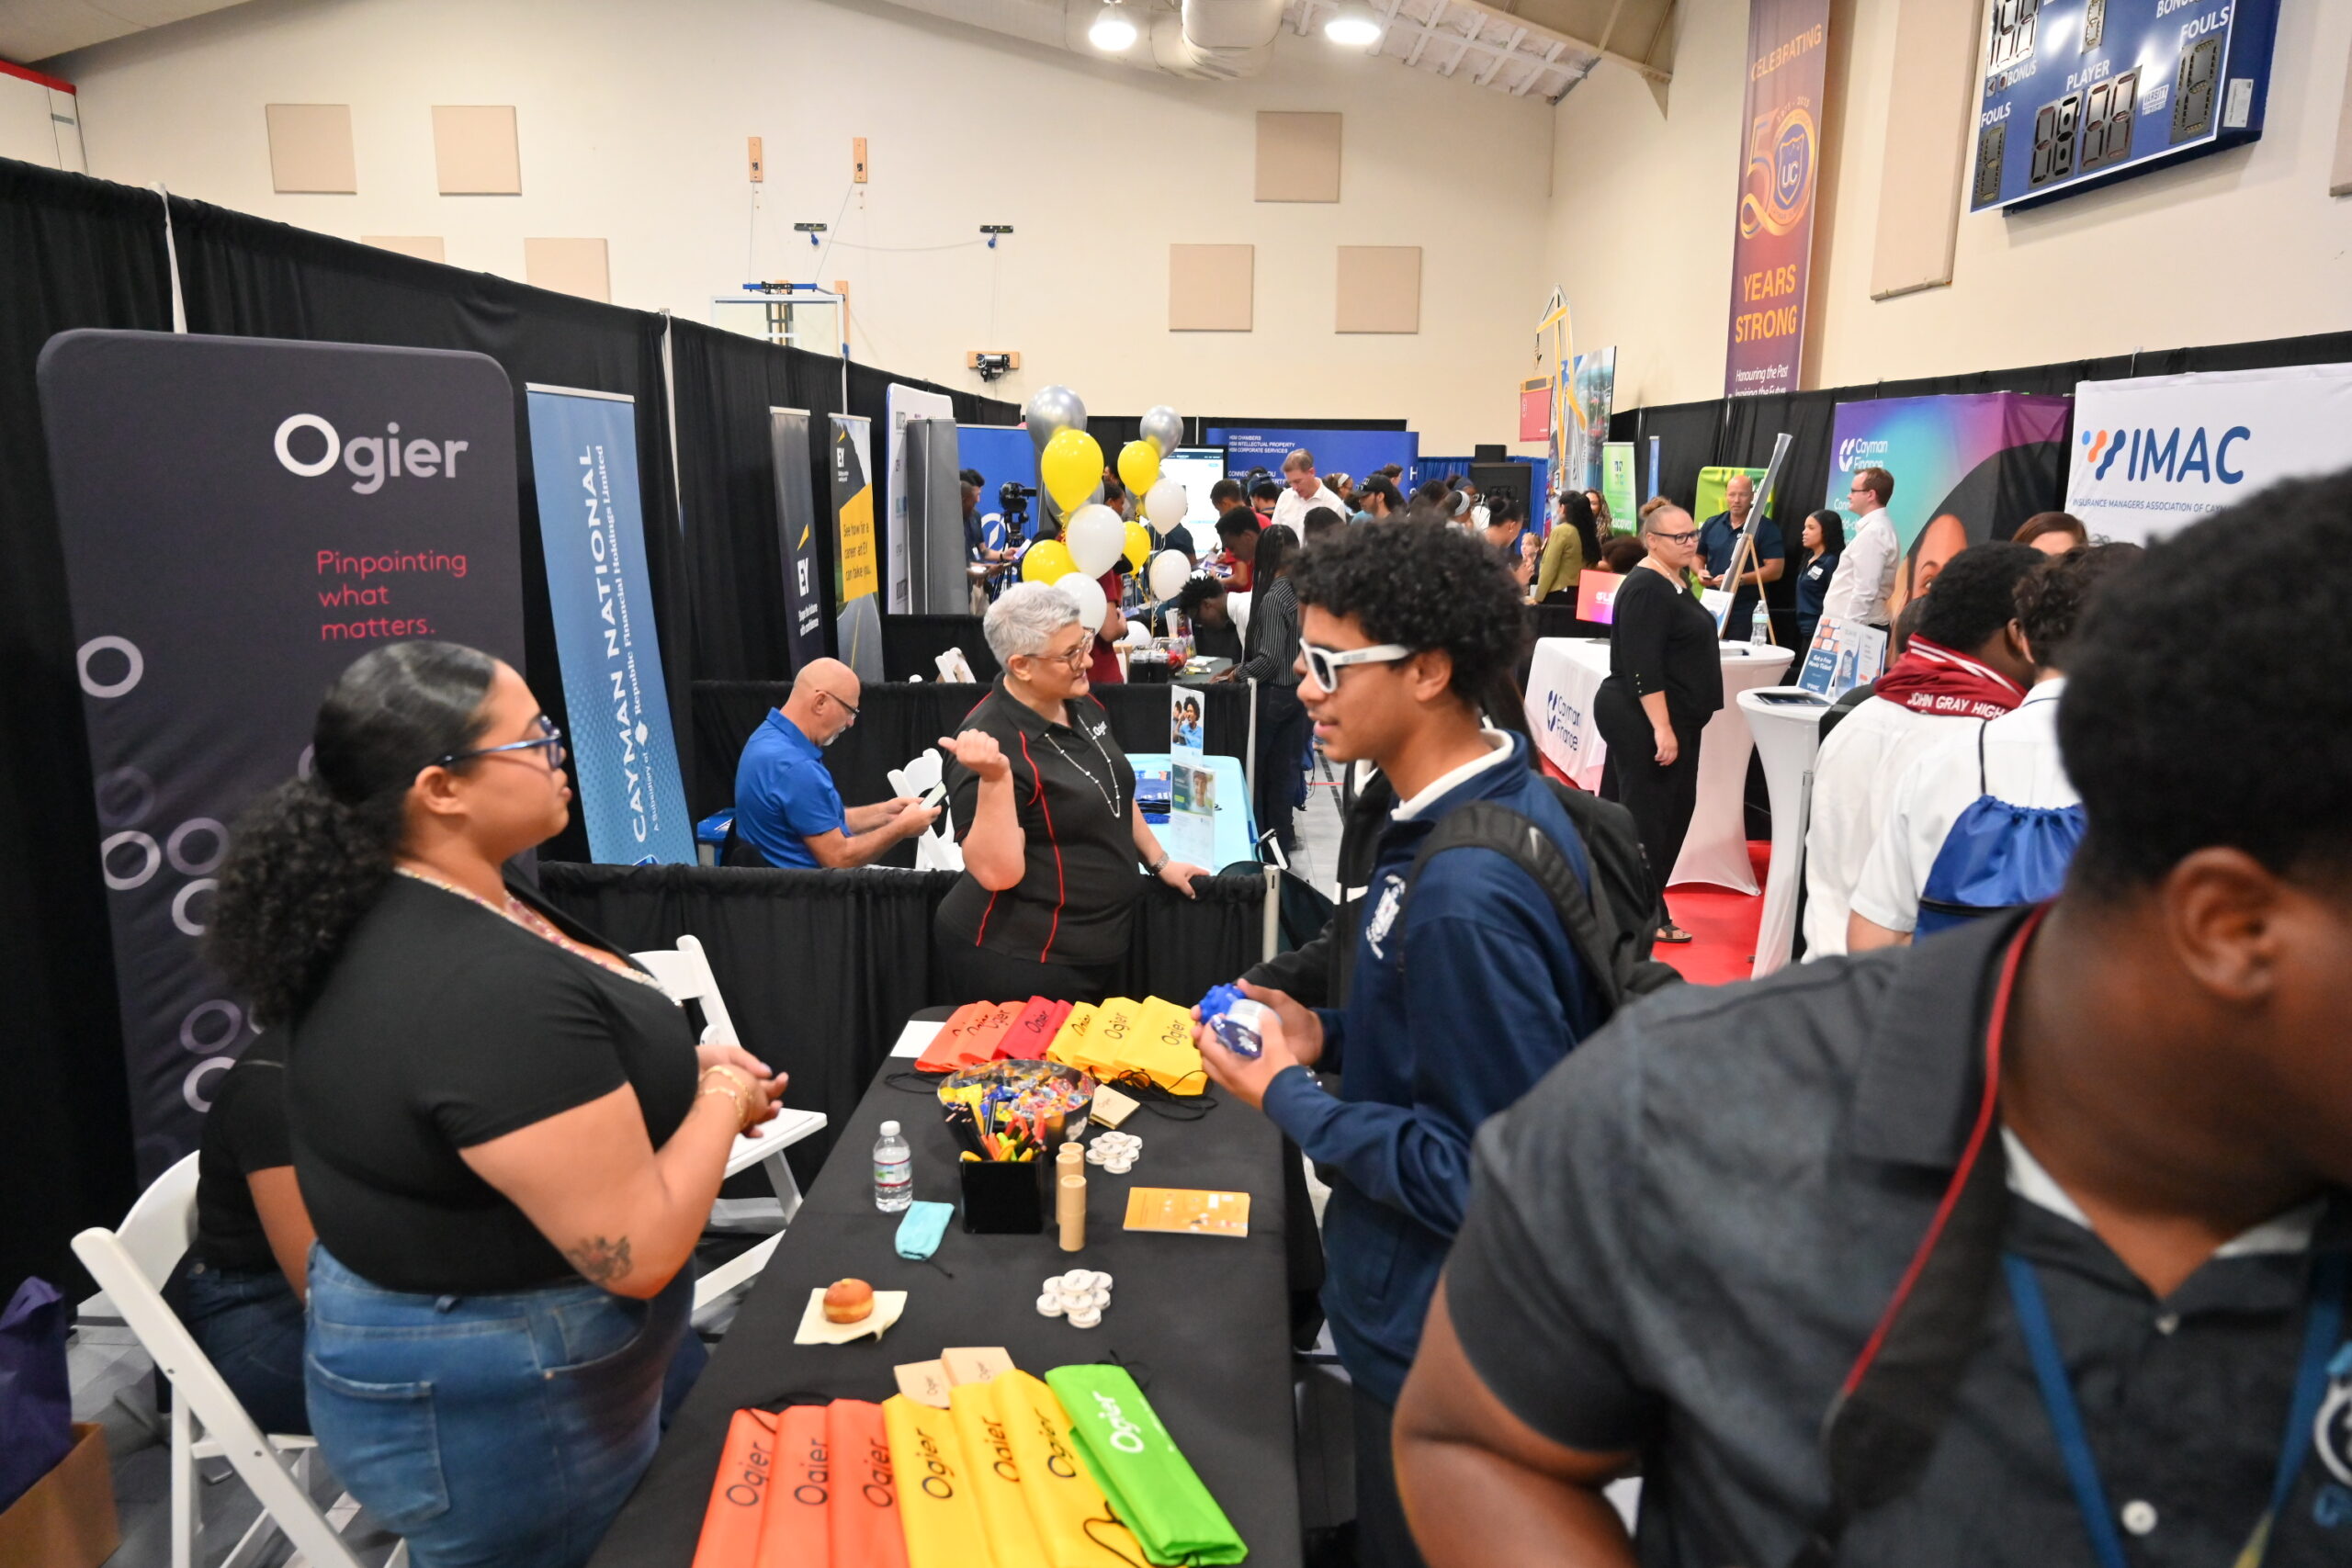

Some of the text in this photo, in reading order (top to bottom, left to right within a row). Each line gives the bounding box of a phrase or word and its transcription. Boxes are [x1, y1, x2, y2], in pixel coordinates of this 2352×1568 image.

[2156, 0, 2203, 18] BON
[2180, 6, 2230, 43] FOULS
[1751, 24, 1823, 82] CELEBRATING
[2007, 62, 2037, 86] BONUS
[2066, 59, 2110, 91] PLAYER
[1981, 101, 2011, 128] FOULS
[1781, 161, 1799, 188] UC
[1744, 264, 1797, 302] YEARS
[1735, 305, 1798, 344] STRONG
[1767, 365, 1777, 378] the
[274, 413, 469, 495] Ogier
[837, 447, 844, 468] EY
[1855, 437, 1888, 457] Cayman
[2128, 425, 2251, 485] IMAC
[595, 446, 611, 504] Limited
[2073, 499, 2227, 513] INSURANCE MANAGERS ASSOCIATION OF CAYM
[603, 506, 621, 574] Holdings
[317, 549, 468, 581] Pinpointing
[797, 558, 808, 597] EY
[318, 583, 390, 607] what
[615, 578, 632, 648] Financial
[322, 617, 436, 641] matters.
[579, 445, 647, 842] CAYMAN NATIONAL
[628, 651, 642, 716] Republic
[1557, 695, 1581, 727] Cayman
[1906, 692, 2006, 720] JOHN GRAY HIGH
[1556, 719, 1578, 751] Finance
[1104, 1011, 1128, 1040] Ogier
[1161, 1019, 1189, 1045] Ogier
[1091, 1390, 1145, 1454] Ogier
[981, 1416, 1021, 1483] Ogier
[1034, 1406, 1077, 1479] Ogier
[725, 1441, 773, 1507] Ogier
[794, 1438, 830, 1506] Ogier
[862, 1438, 894, 1508] Ogier
[915, 1427, 956, 1500] Ogier
